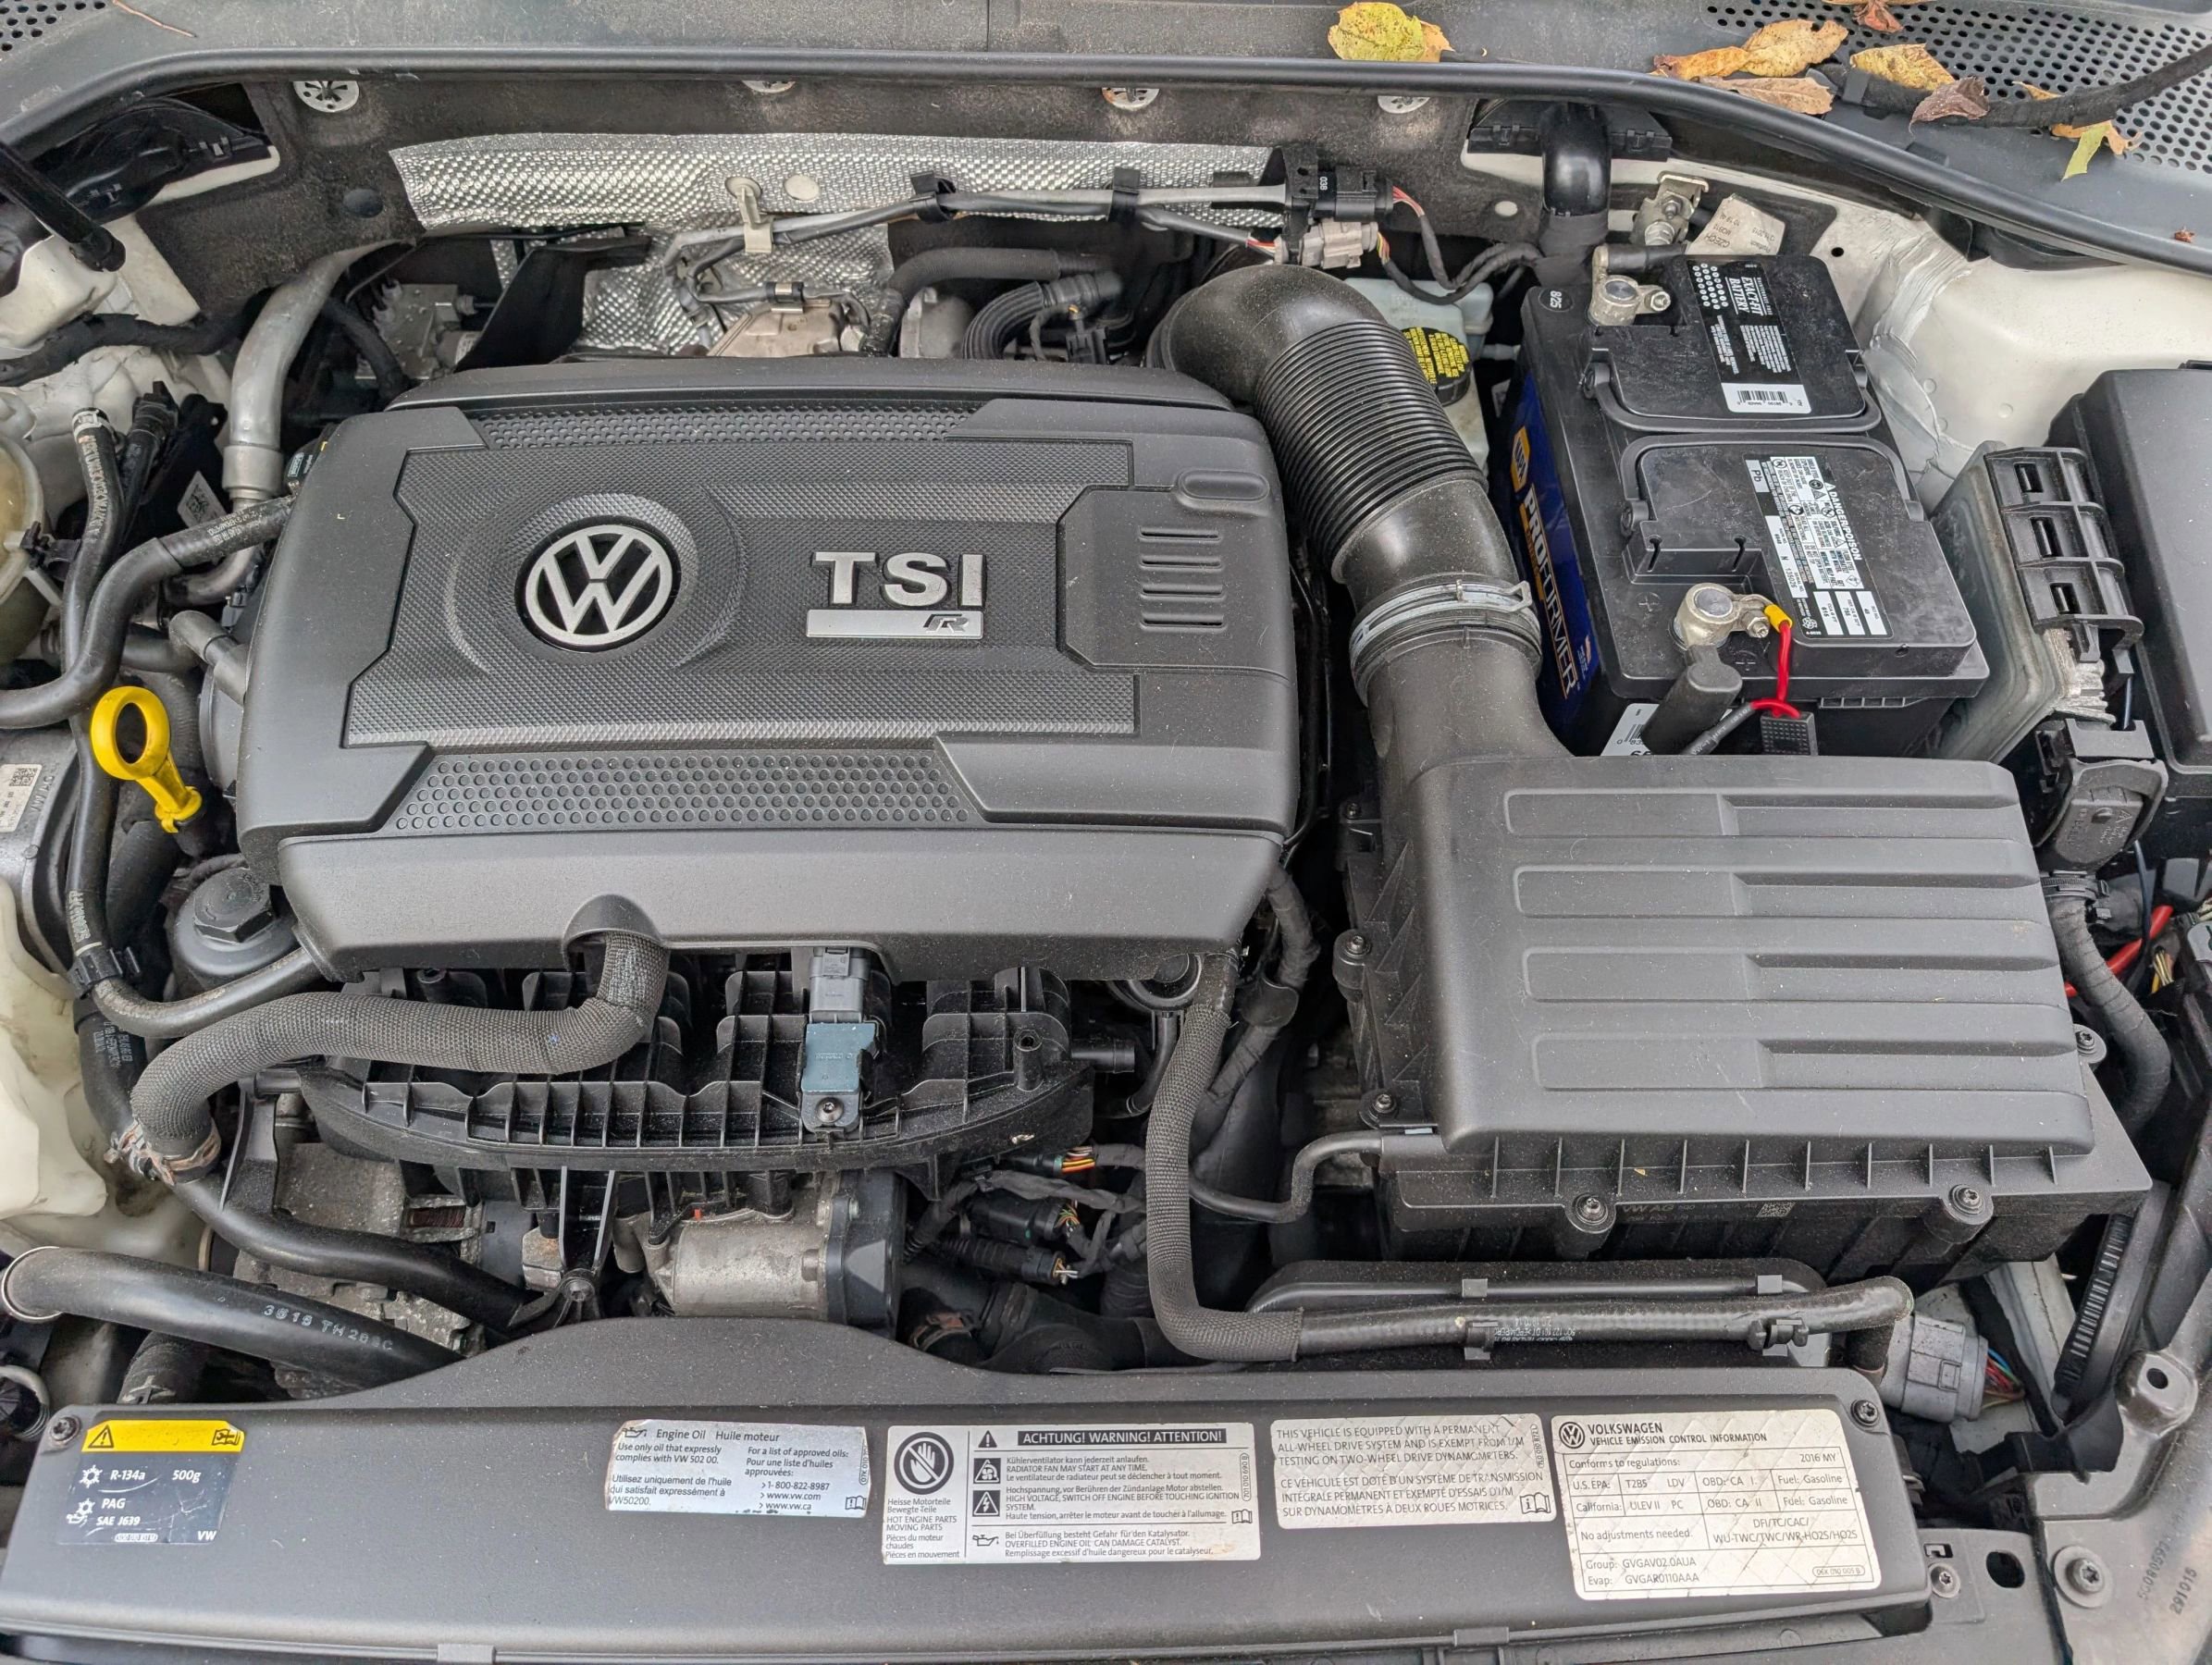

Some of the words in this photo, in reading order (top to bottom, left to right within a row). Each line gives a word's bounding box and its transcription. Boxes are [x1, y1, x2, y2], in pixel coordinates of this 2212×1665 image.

[1319, 176, 1328, 191] 038
[1550, 290, 1563, 309] 8/25
[1729, 278, 1750, 313] BATTERY
[1741, 277, 1764, 316] EXACT-FIT
[1751, 470, 1761, 482] Pb
[1829, 491, 1862, 561] DANGER/POISON
[814, 551, 986, 608] TSI
[1525, 487, 1577, 695] PROFORMER
[1277, 1430, 1298, 1438] THIS
[1302, 1428, 1341, 1437] VEHICLE
[1343, 1428, 1352, 1437] IS
[1354, 1426, 1403, 1437] EQUIPPED
[1404, 1425, 1430, 1435] WITH
[1434, 1425, 1441, 1434] A
[1443, 1425, 1500, 1434] PERMANENT
[1588, 1423, 1663, 1434] VOLKSWAGEN
[657, 1429, 689, 1441] Engine
[692, 1430, 705, 1439] Oil
[716, 1431, 740, 1441] Huile
[744, 1433, 779, 1441] moteur
[1022, 1432, 1085, 1444] ACHTUNG!
[1089, 1432, 1150, 1442] WARNING!
[1154, 1431, 1221, 1442] ATTENTION!
[1590, 1437, 1623, 1445] VEHICLE
[1626, 1436, 1665, 1445] EMISSION
[1669, 1434, 1707, 1444] CONTROL
[1711, 1434, 1767, 1442] INFORMATION
[618, 1443, 633, 1451] Use
[635, 1444, 650, 1453] only
[653, 1444, 663, 1452] oil
[685, 1445, 722, 1455] expressly
[1278, 1442, 1331, 1451] ALL-WHEEL
[1334, 1441, 1363, 1450] DRIVE
[1366, 1440, 1401, 1449] SYSTEM
[1404, 1439, 1425, 1449] AND
[1428, 1439, 1436, 1448] IS
[1440, 1438, 1475, 1448] EXEMPT
[1478, 1437, 1505, 1447] FROM
[748, 1447, 759, 1455] For
[784, 1448, 792, 1456] of
[793, 1448, 830, 1458] approved
[833, 1449, 848, 1457] oils:
[1800, 1453, 1821, 1462] 2016
[616, 1454, 650, 1463] complies
[654, 1454, 672, 1462] with
[674, 1454, 688, 1462] VW
[706, 1455, 718, 1463] 00.
[747, 1458, 764, 1466] Pour
[783, 1459, 800, 1467] liste
[802, 1459, 833, 1468] d'huiles
[1279, 1456, 1319, 1466] TESTING
[1322, 1455, 1338, 1464] ON
[1340, 1454, 1402, 1463] TWO-WHEEL
[1404, 1453, 1436, 1462] DRIVE
[1570, 1460, 1613, 1468] Conforms
[1627, 1459, 1680, 1470] regulations:
[110, 1470, 145, 1481] R-134a
[172, 1470, 202, 1483] 500g
[745, 1468, 793, 1477] approuvées:
[612, 1474, 641, 1484] Utilisez
[644, 1475, 693, 1486] uniquement
[708, 1477, 732, 1486] l'huile
[1574, 1481, 1589, 1489] U.S.
[1591, 1481, 1610, 1489] EPA:
[1667, 1478, 1685, 1487] LDV
[1703, 1477, 1726, 1486] OBD:
[1730, 1476, 1743, 1486] CA
[1778, 1474, 1799, 1485] Fuel:
[1804, 1474, 1842, 1484] Gasoline
[610, 1486, 622, 1497] qui
[624, 1486, 657, 1494] satisfait
[659, 1486, 718, 1498] expressément
[720, 1488, 725, 1497] à
[767, 1492, 821, 1500] www.vw.com
[102, 1498, 126, 1509] PAG
[766, 1502, 811, 1511] www.vw.ca
[1630, 1501, 1652, 1510] ULEV
[1654, 1500, 1660, 1510] II
[1672, 1500, 1683, 1509] PC
[1708, 1499, 1731, 1508] OBD:
[1736, 1498, 1749, 1507] CA
[1756, 1498, 1761, 1506] II
[1784, 1497, 1804, 1506] Fuel:
[1809, 1496, 1847, 1505] Gasoline
[888, 1506, 919, 1514] Bewegte
[1576, 1502, 1622, 1512] California:
[96, 1516, 114, 1525] SAE
[117, 1516, 141, 1526] J639
[197, 1531, 216, 1540] VW
[1581, 1532, 1594, 1540] No
[1597, 1530, 1653, 1542] adjustments
[1657, 1529, 1692, 1537] needed.
[1586, 1560, 1617, 1571] Group:
[1588, 1576, 1613, 1585] Evap:
